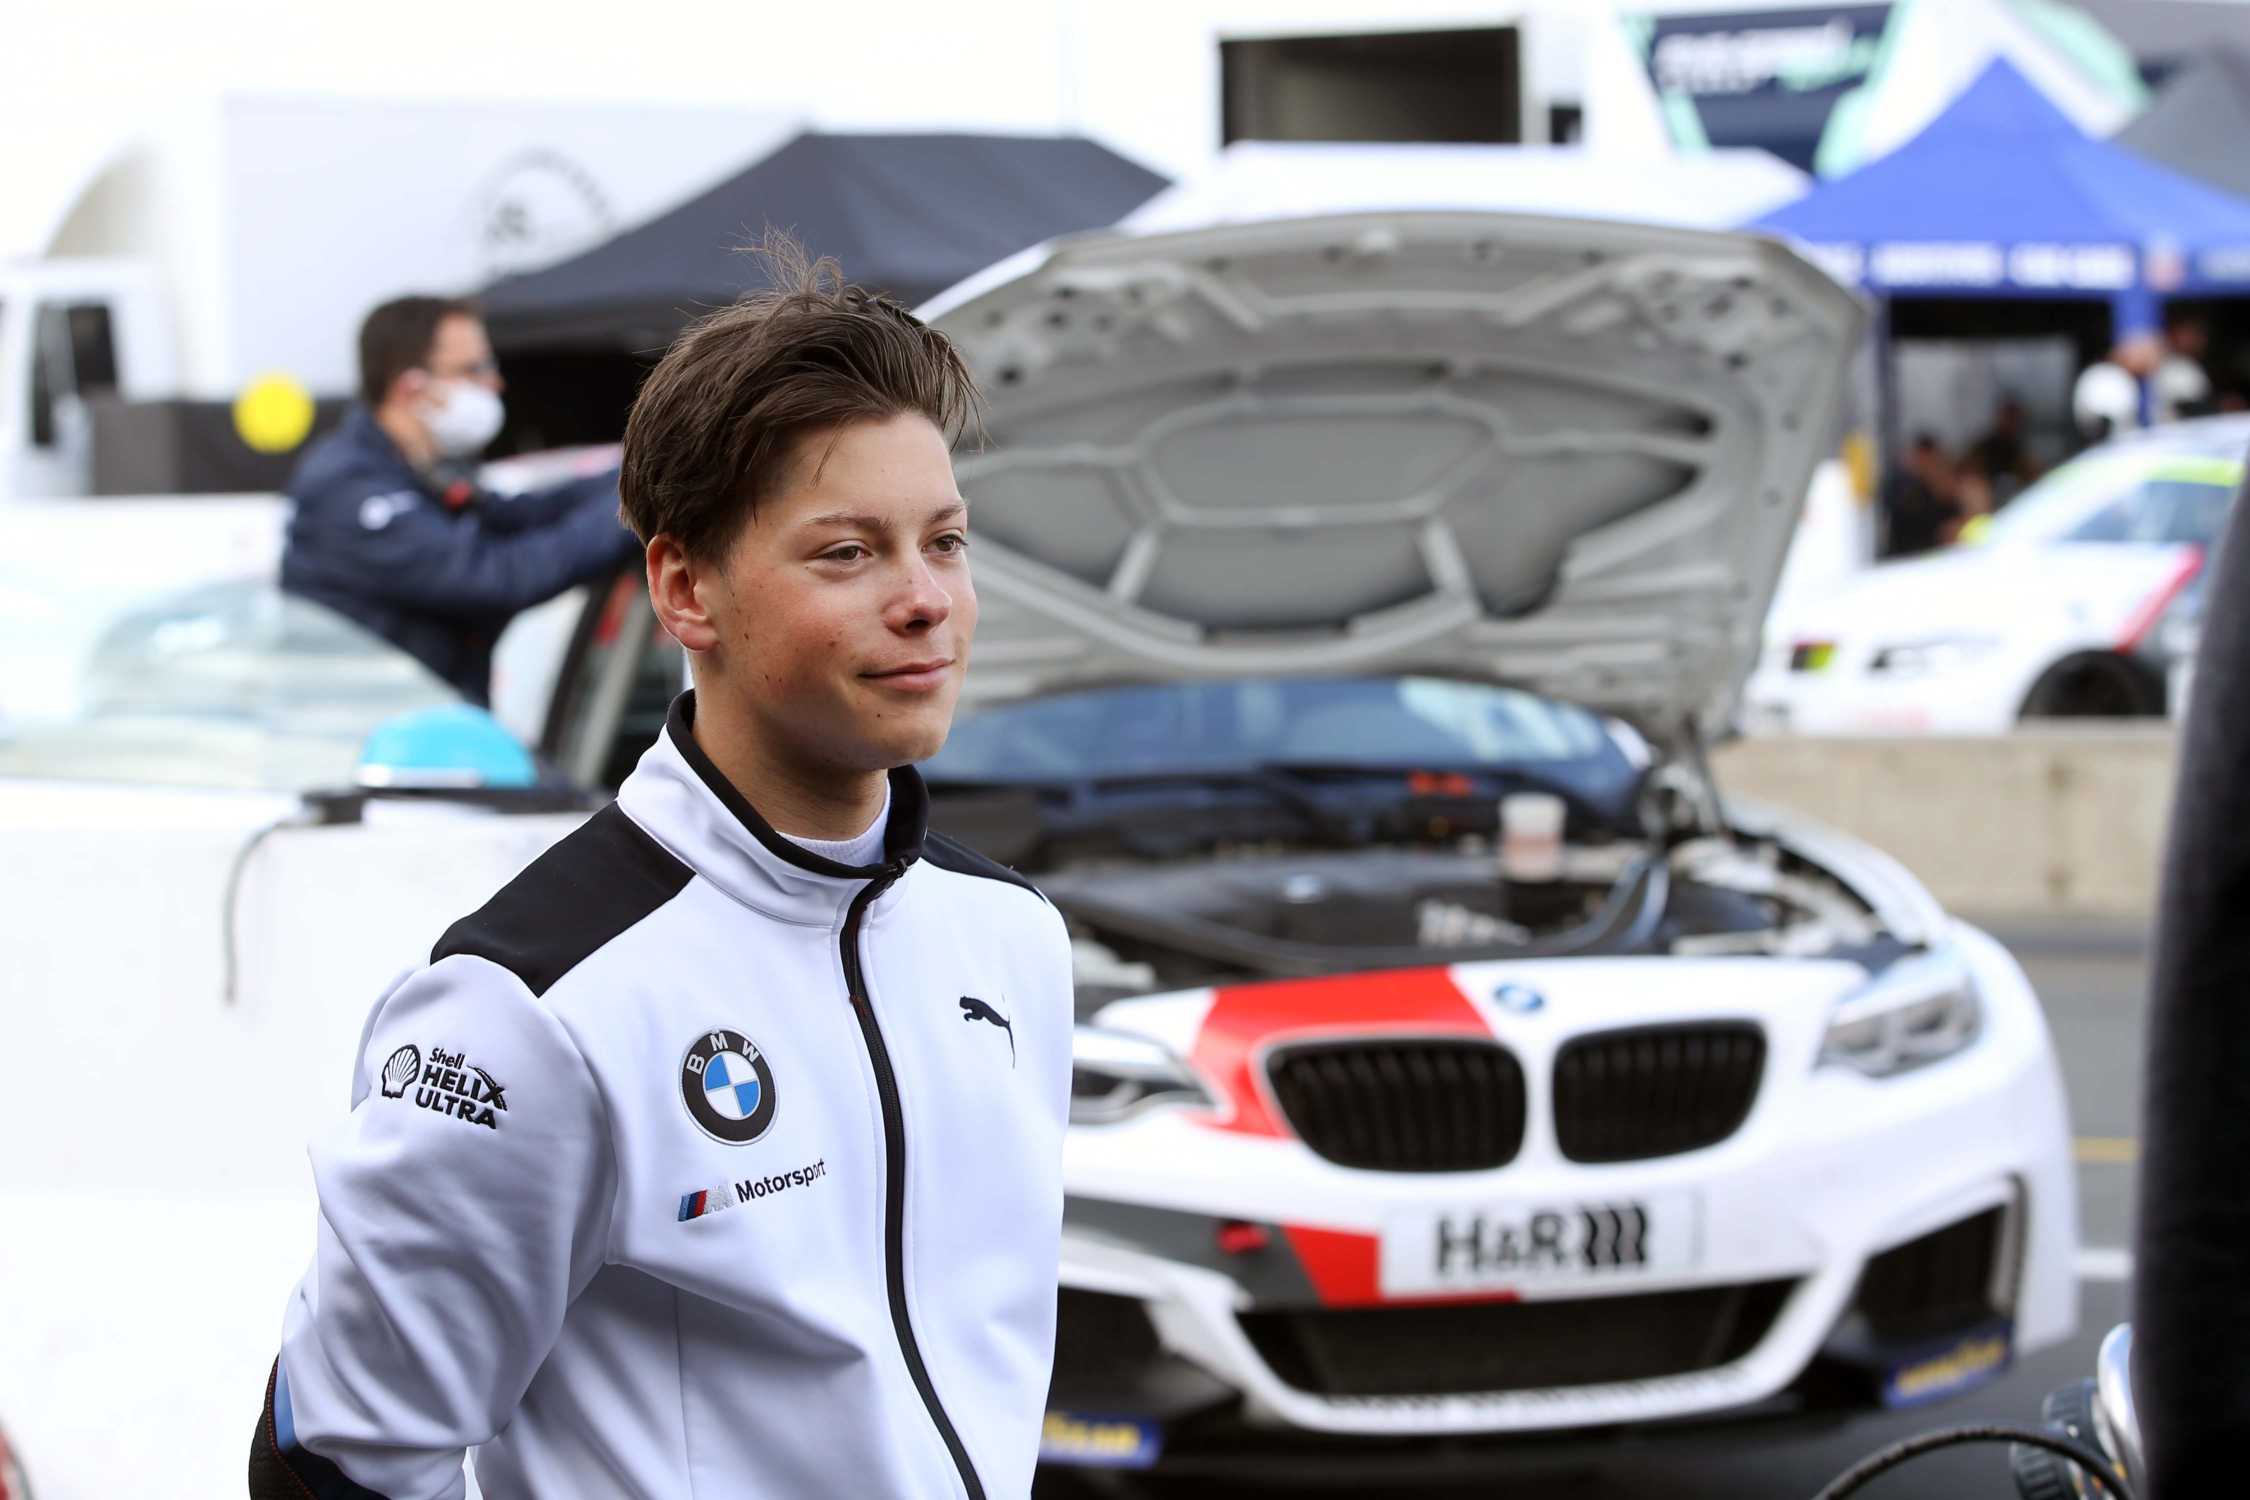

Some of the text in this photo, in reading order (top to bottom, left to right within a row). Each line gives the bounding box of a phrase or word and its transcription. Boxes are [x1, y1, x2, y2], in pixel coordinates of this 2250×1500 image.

[428, 1047, 466, 1070] Shell
[686, 1032, 760, 1075] BMW
[415, 1087, 497, 1130] ULTRA
[421, 1064, 508, 1112] HELIX
[735, 1158, 827, 1204] Motorsport
[1437, 1208, 1566, 1273] H&R
